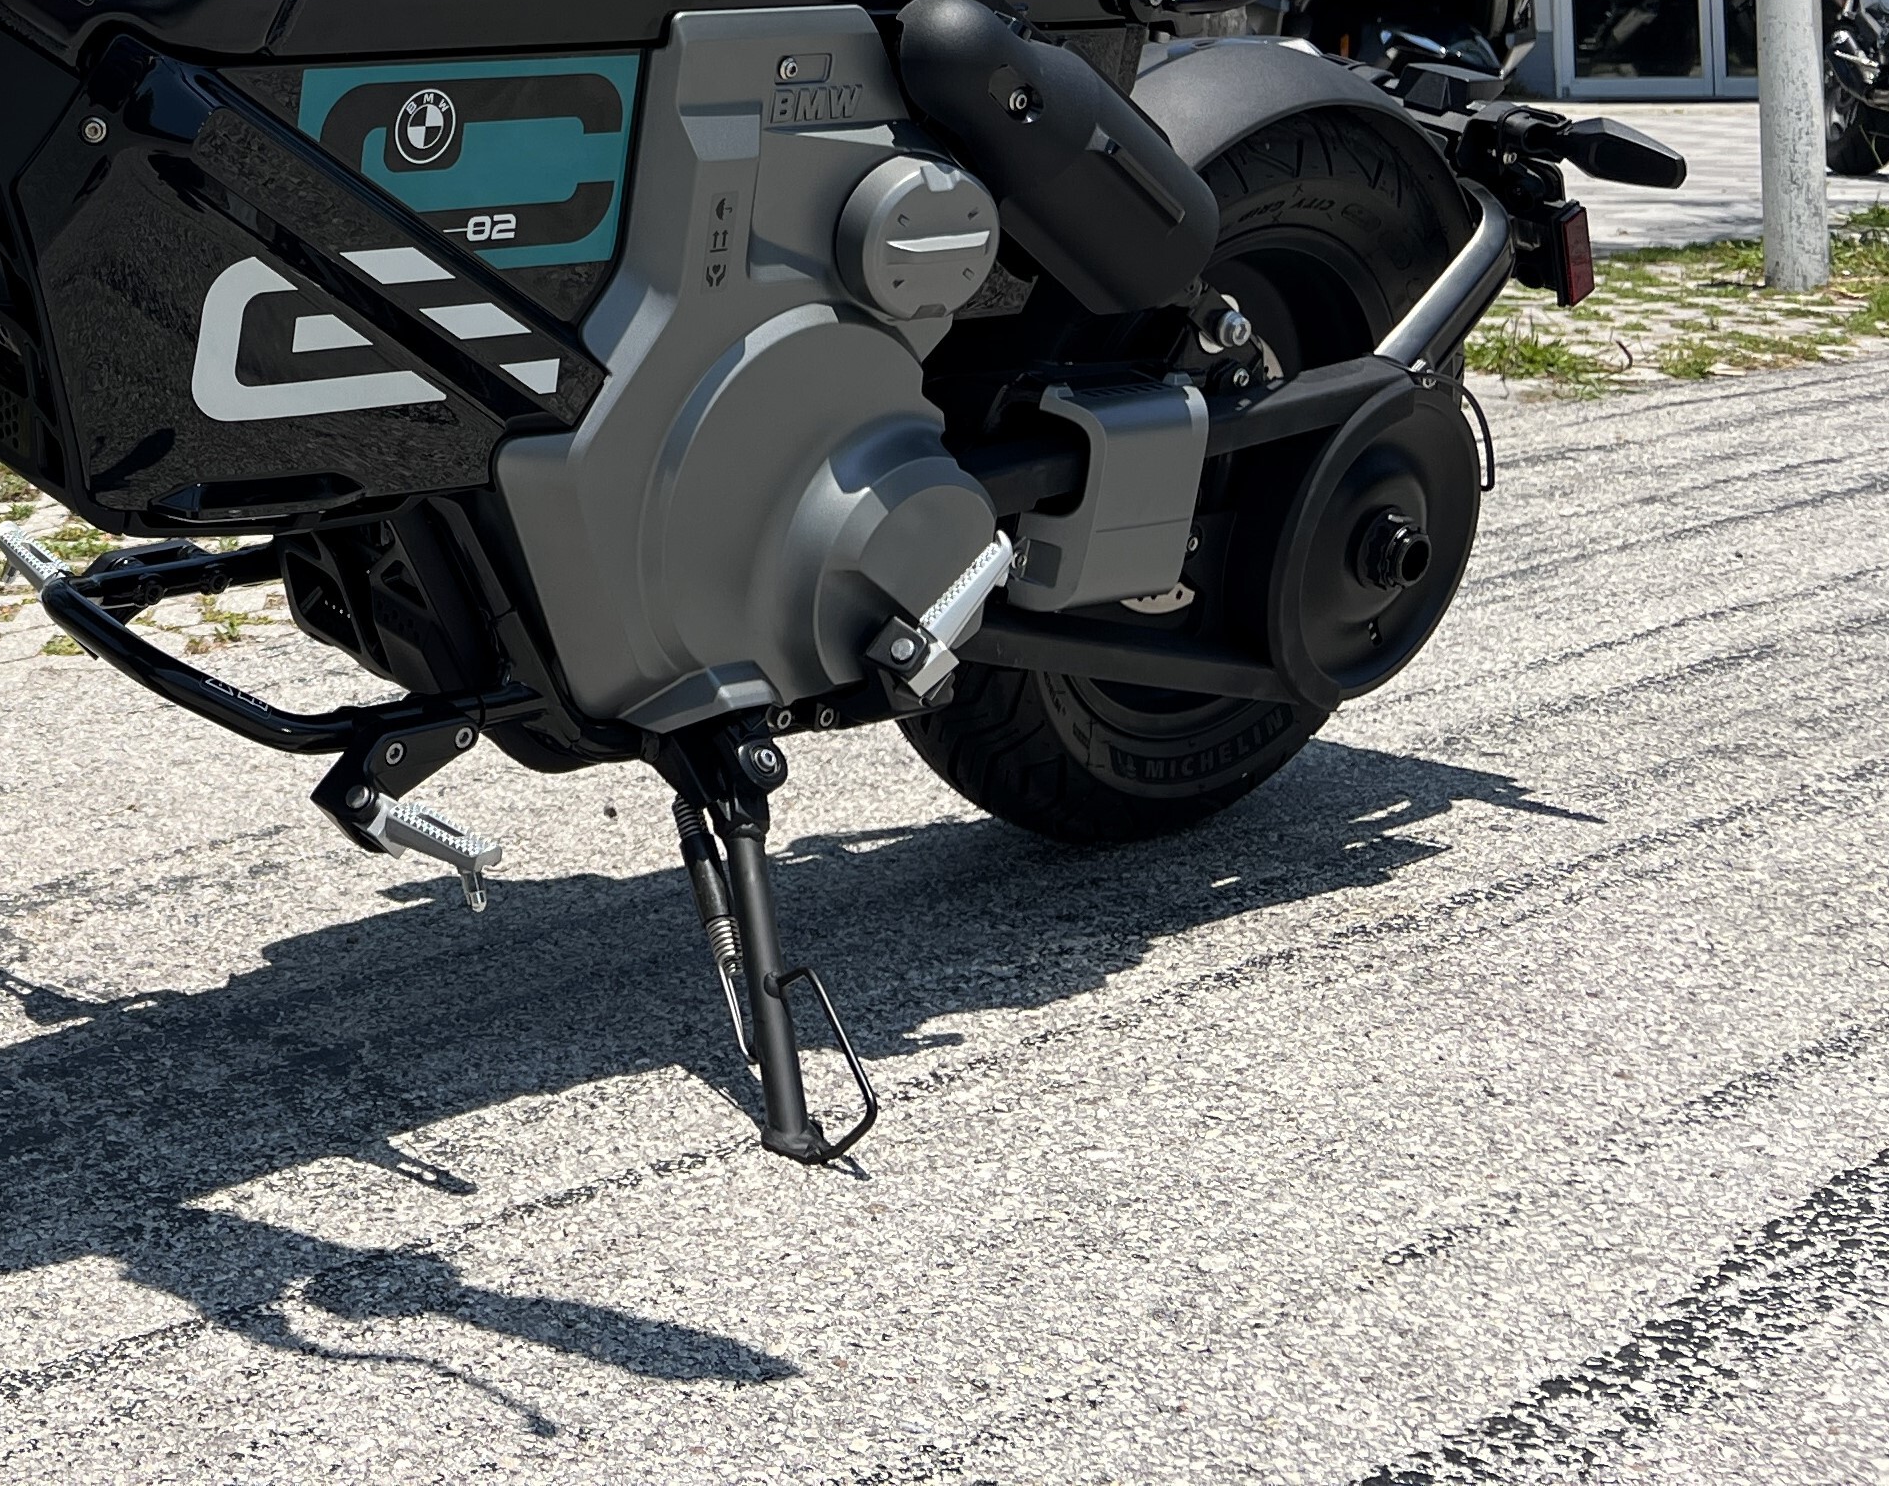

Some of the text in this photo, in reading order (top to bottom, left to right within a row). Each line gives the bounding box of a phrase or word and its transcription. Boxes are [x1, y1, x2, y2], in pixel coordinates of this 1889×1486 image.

[405, 91, 451, 115] BMW
[768, 83, 864, 125] BMW
[465, 213, 517, 242] 02
